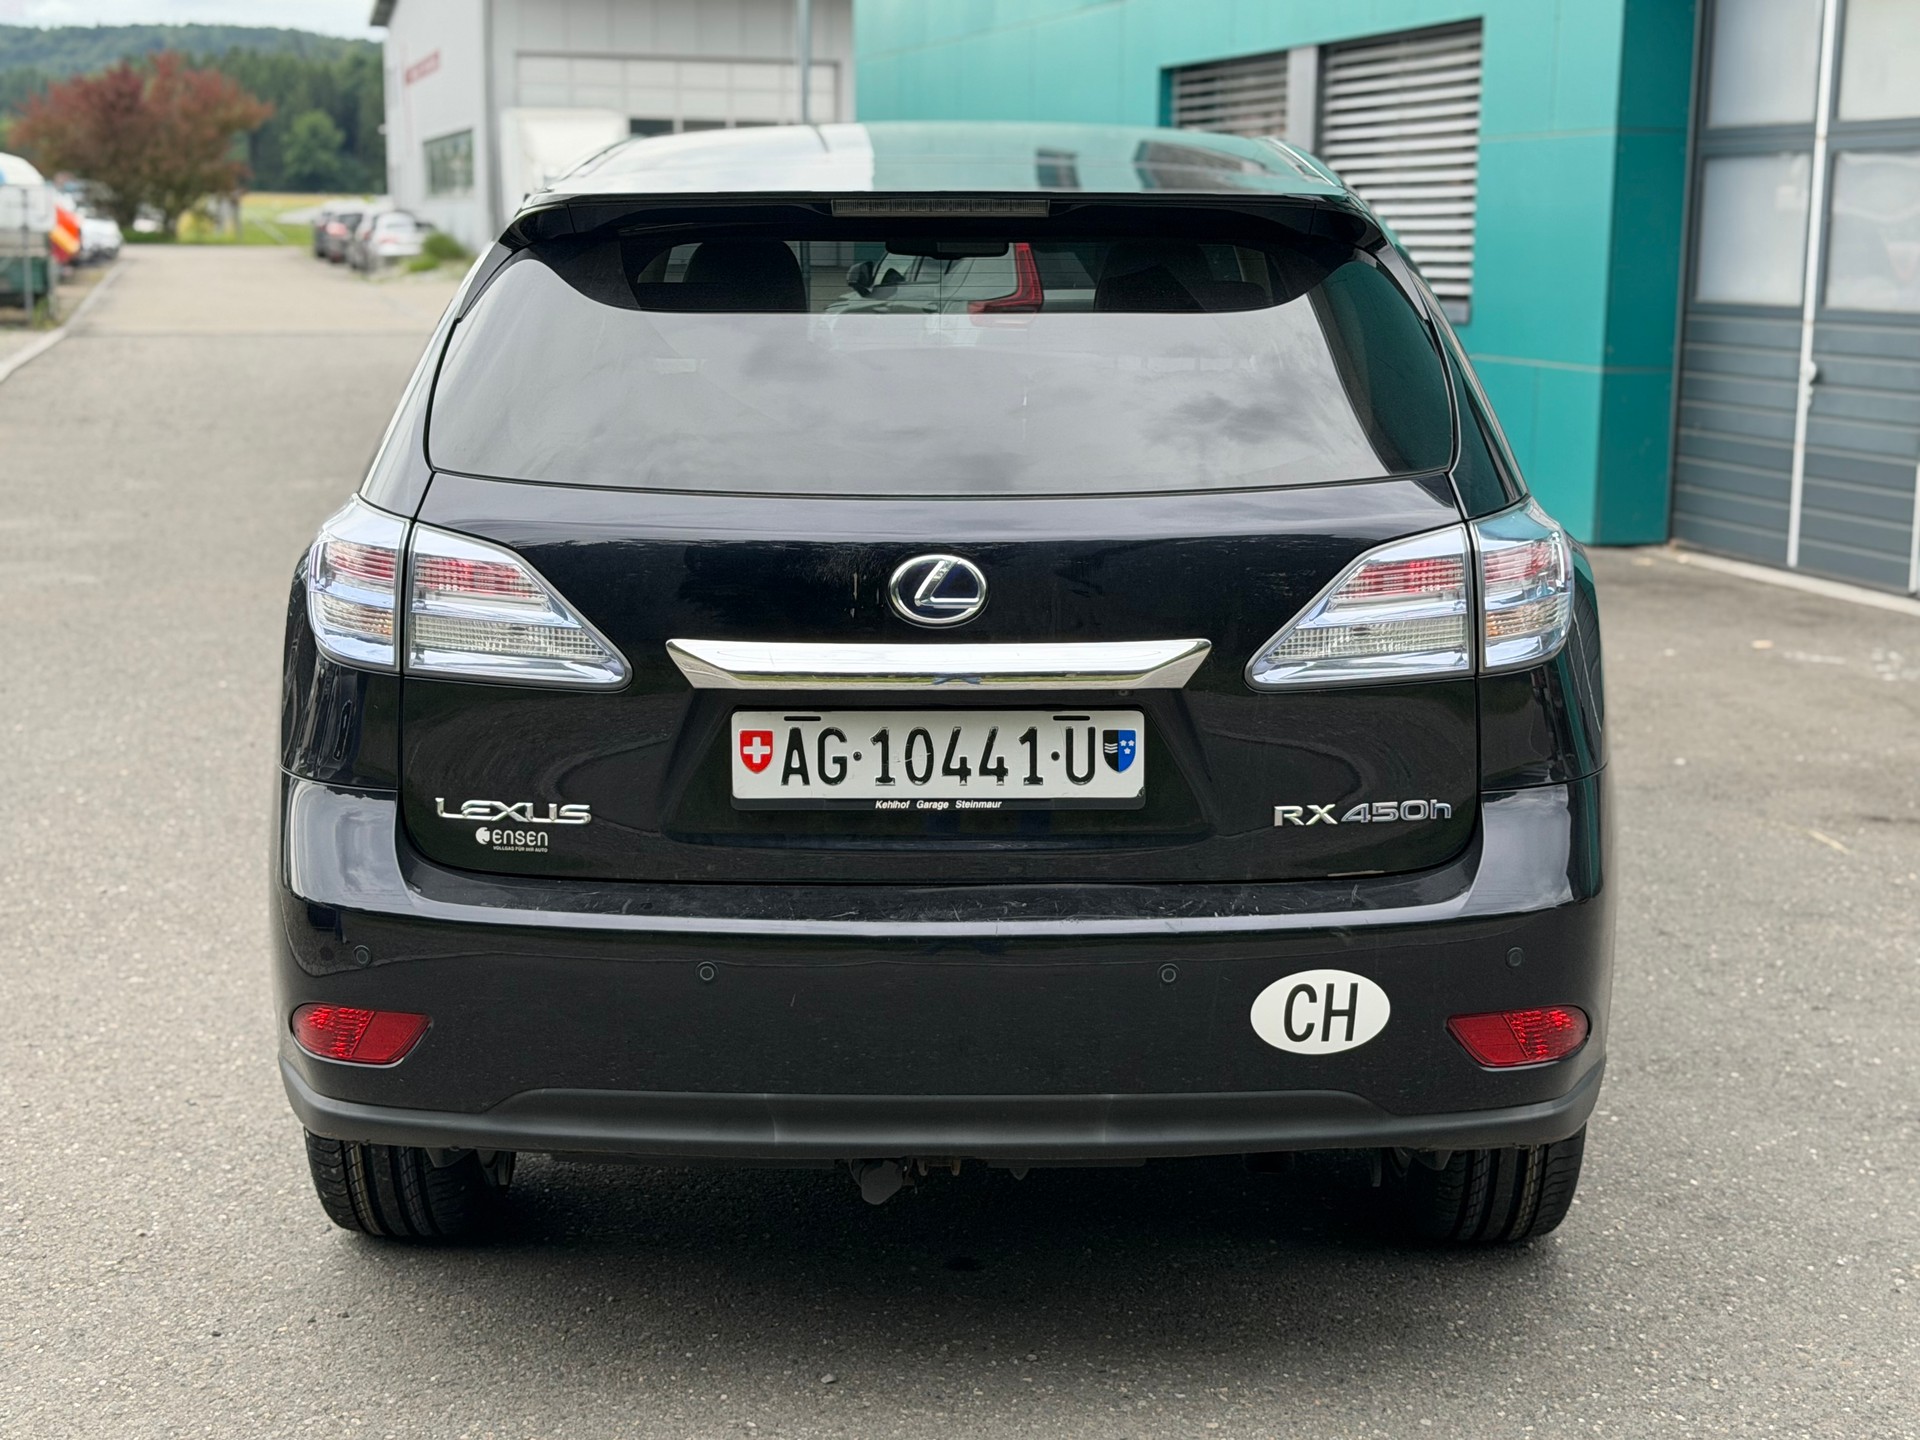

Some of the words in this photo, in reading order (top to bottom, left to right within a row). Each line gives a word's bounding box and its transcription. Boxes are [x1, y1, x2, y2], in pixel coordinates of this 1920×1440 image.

[434, 797, 592, 825] LEXUS
[875, 800, 911, 809] Kehlhof
[916, 800, 949, 811] Garage
[955, 799, 1003, 809] Steinmaur
[1283, 982, 1359, 1043] CH
